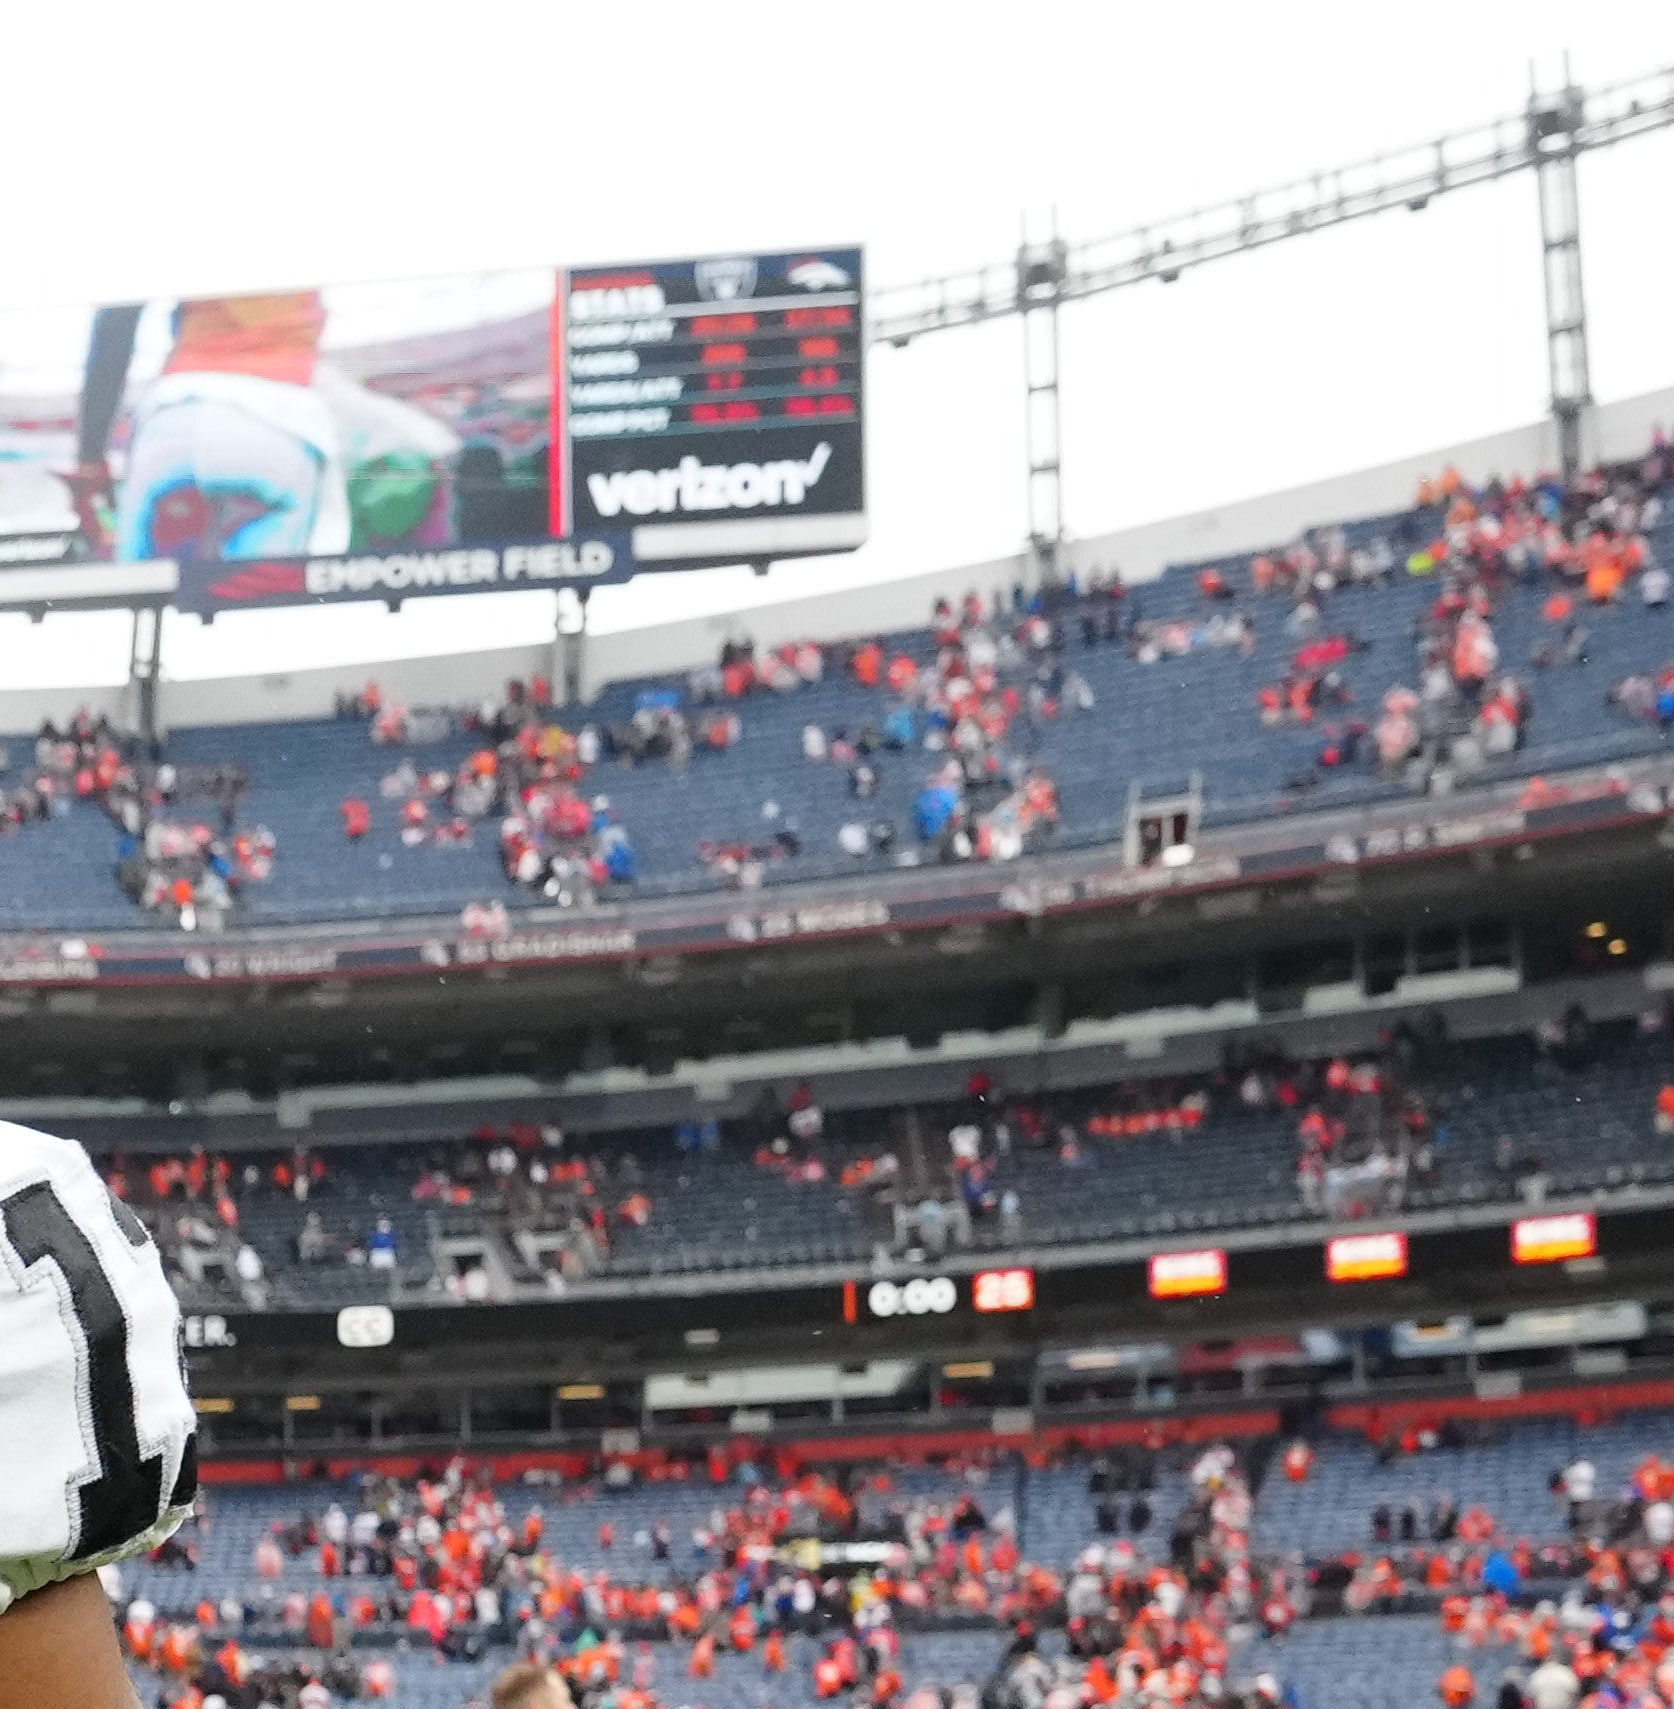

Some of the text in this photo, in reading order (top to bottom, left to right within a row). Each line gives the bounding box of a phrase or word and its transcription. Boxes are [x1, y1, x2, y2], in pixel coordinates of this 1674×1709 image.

[587, 455, 806, 516] verizon
[306, 541, 614, 594] EMPOWER FIELD
[868, 1276, 957, 1318] 0:00
